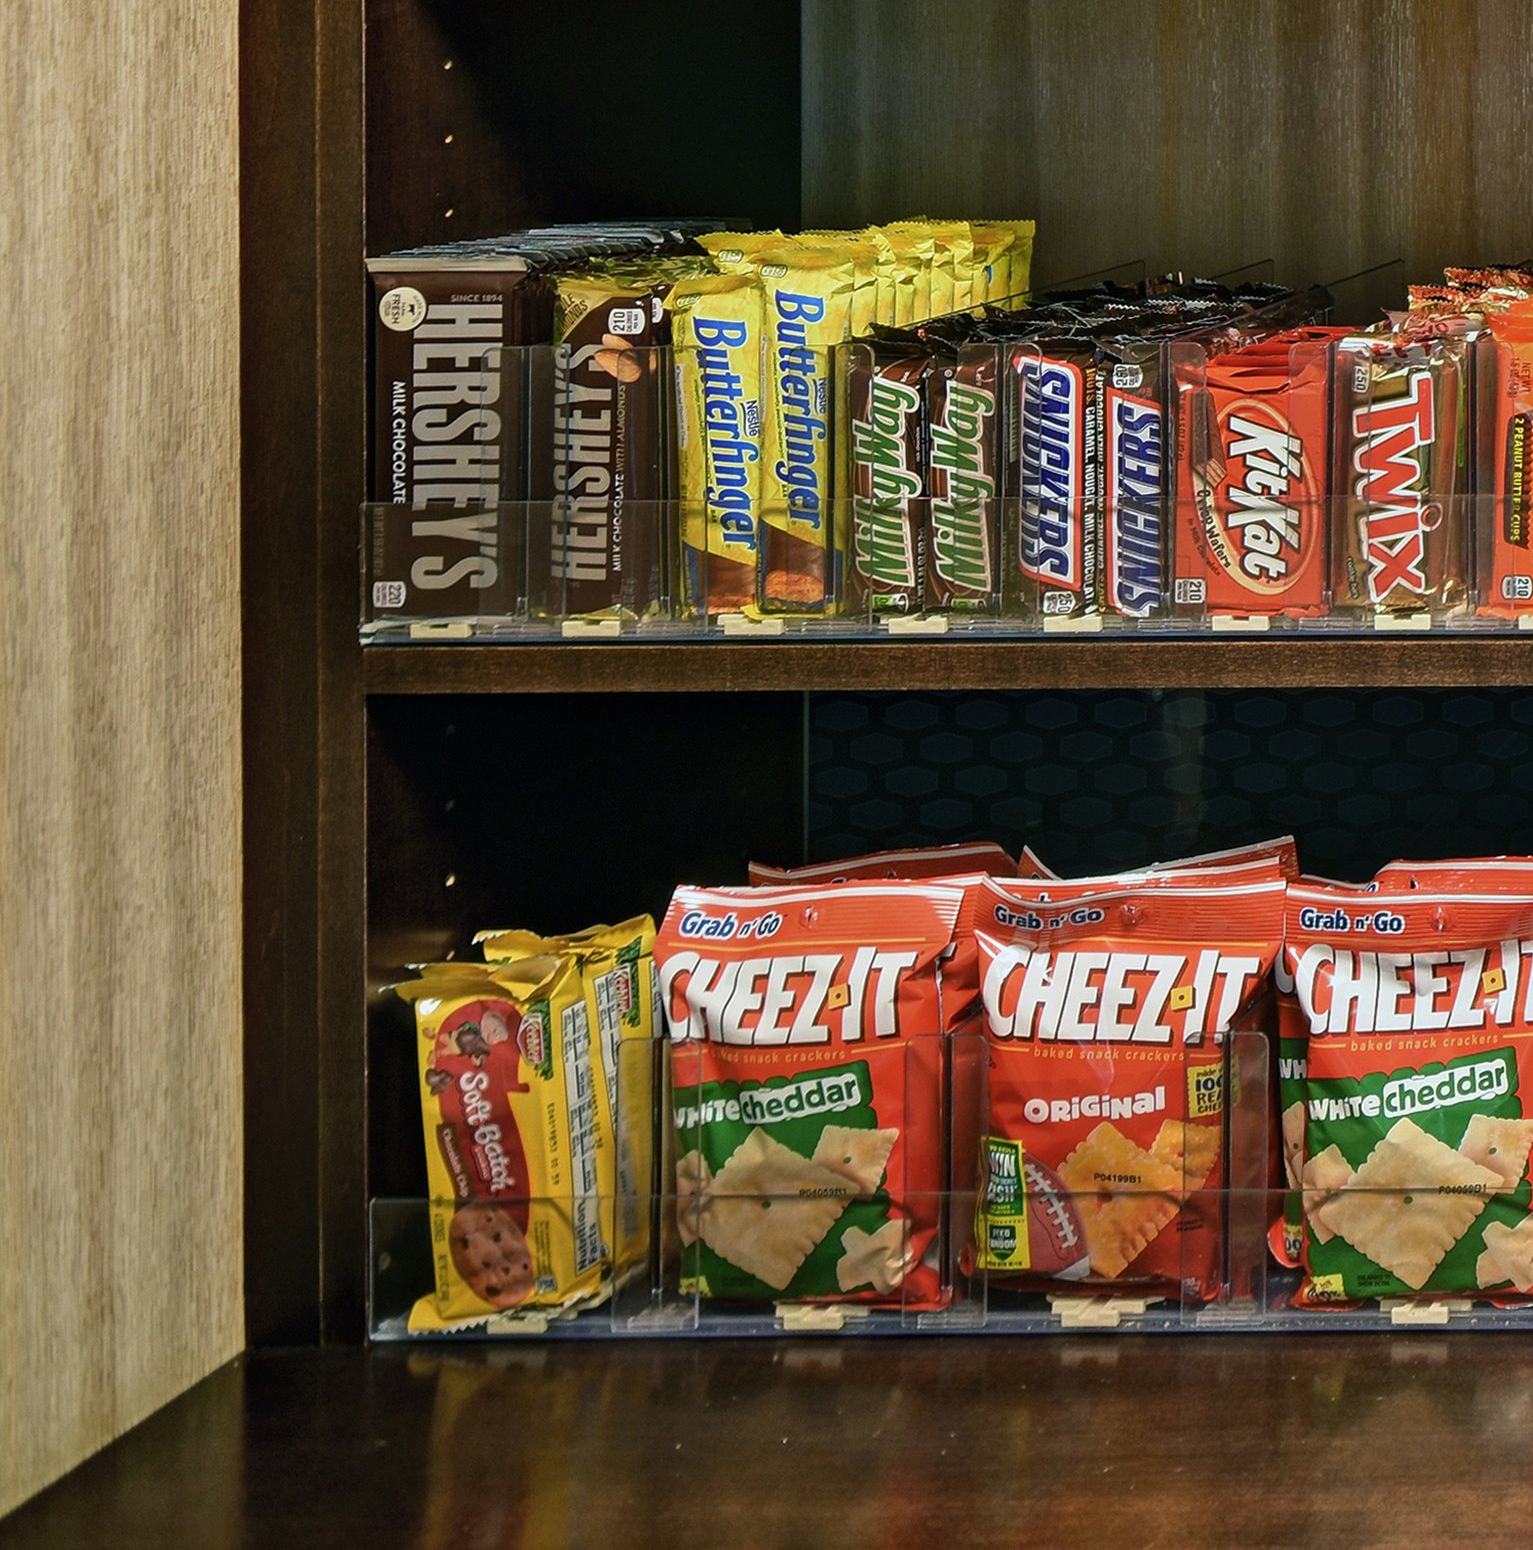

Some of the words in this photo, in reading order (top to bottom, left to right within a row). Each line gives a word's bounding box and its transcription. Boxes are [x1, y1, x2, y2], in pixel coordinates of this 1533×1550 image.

[451, 295, 478, 303] SINCE
[392, 381, 406, 412] MILK
[775, 290, 825, 528] Butterfinger
[392, 416, 406, 503] CHOCOLATE
[410, 303, 503, 590] HERSHEY'S
[692, 316, 757, 550] Butterfinger
[1301, 908, 1347, 932] Grab
[1373, 912, 1402, 932] Go
[1033, 1047, 1076, 1061] baked
[1079, 1049, 1122, 1059] snack
[1125, 1049, 1185, 1061] crackers
[1383, 1063, 1506, 1117] cheddar
